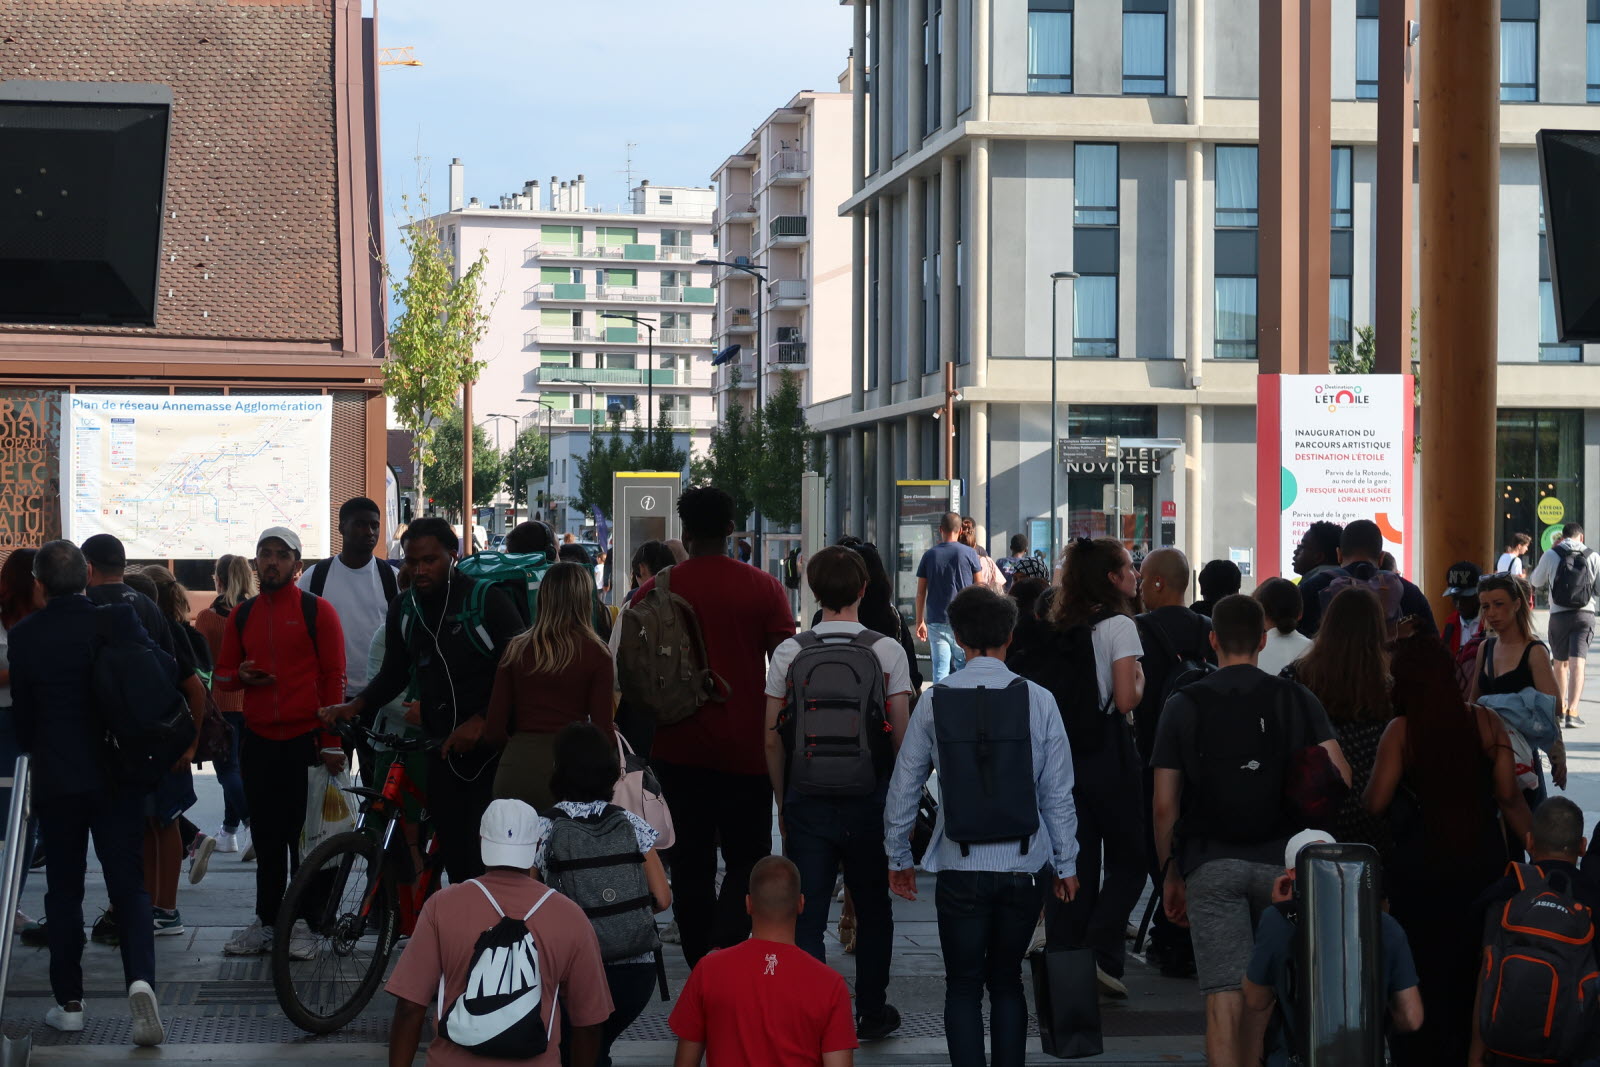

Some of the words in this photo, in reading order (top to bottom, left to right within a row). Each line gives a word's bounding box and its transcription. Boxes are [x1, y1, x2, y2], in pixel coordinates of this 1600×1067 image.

[72, 399, 98, 410] Plan
[102, 400, 117, 410] de
[120, 400, 158, 410] réseau
[162, 400, 231, 410] Annemasse
[235, 400, 322, 413] Agglomération
[1351, 452, 1384, 461] L'ÉTOILE
[1067, 461, 1160, 473] NOVOTEL
[1449, 570, 1471, 584] NY
